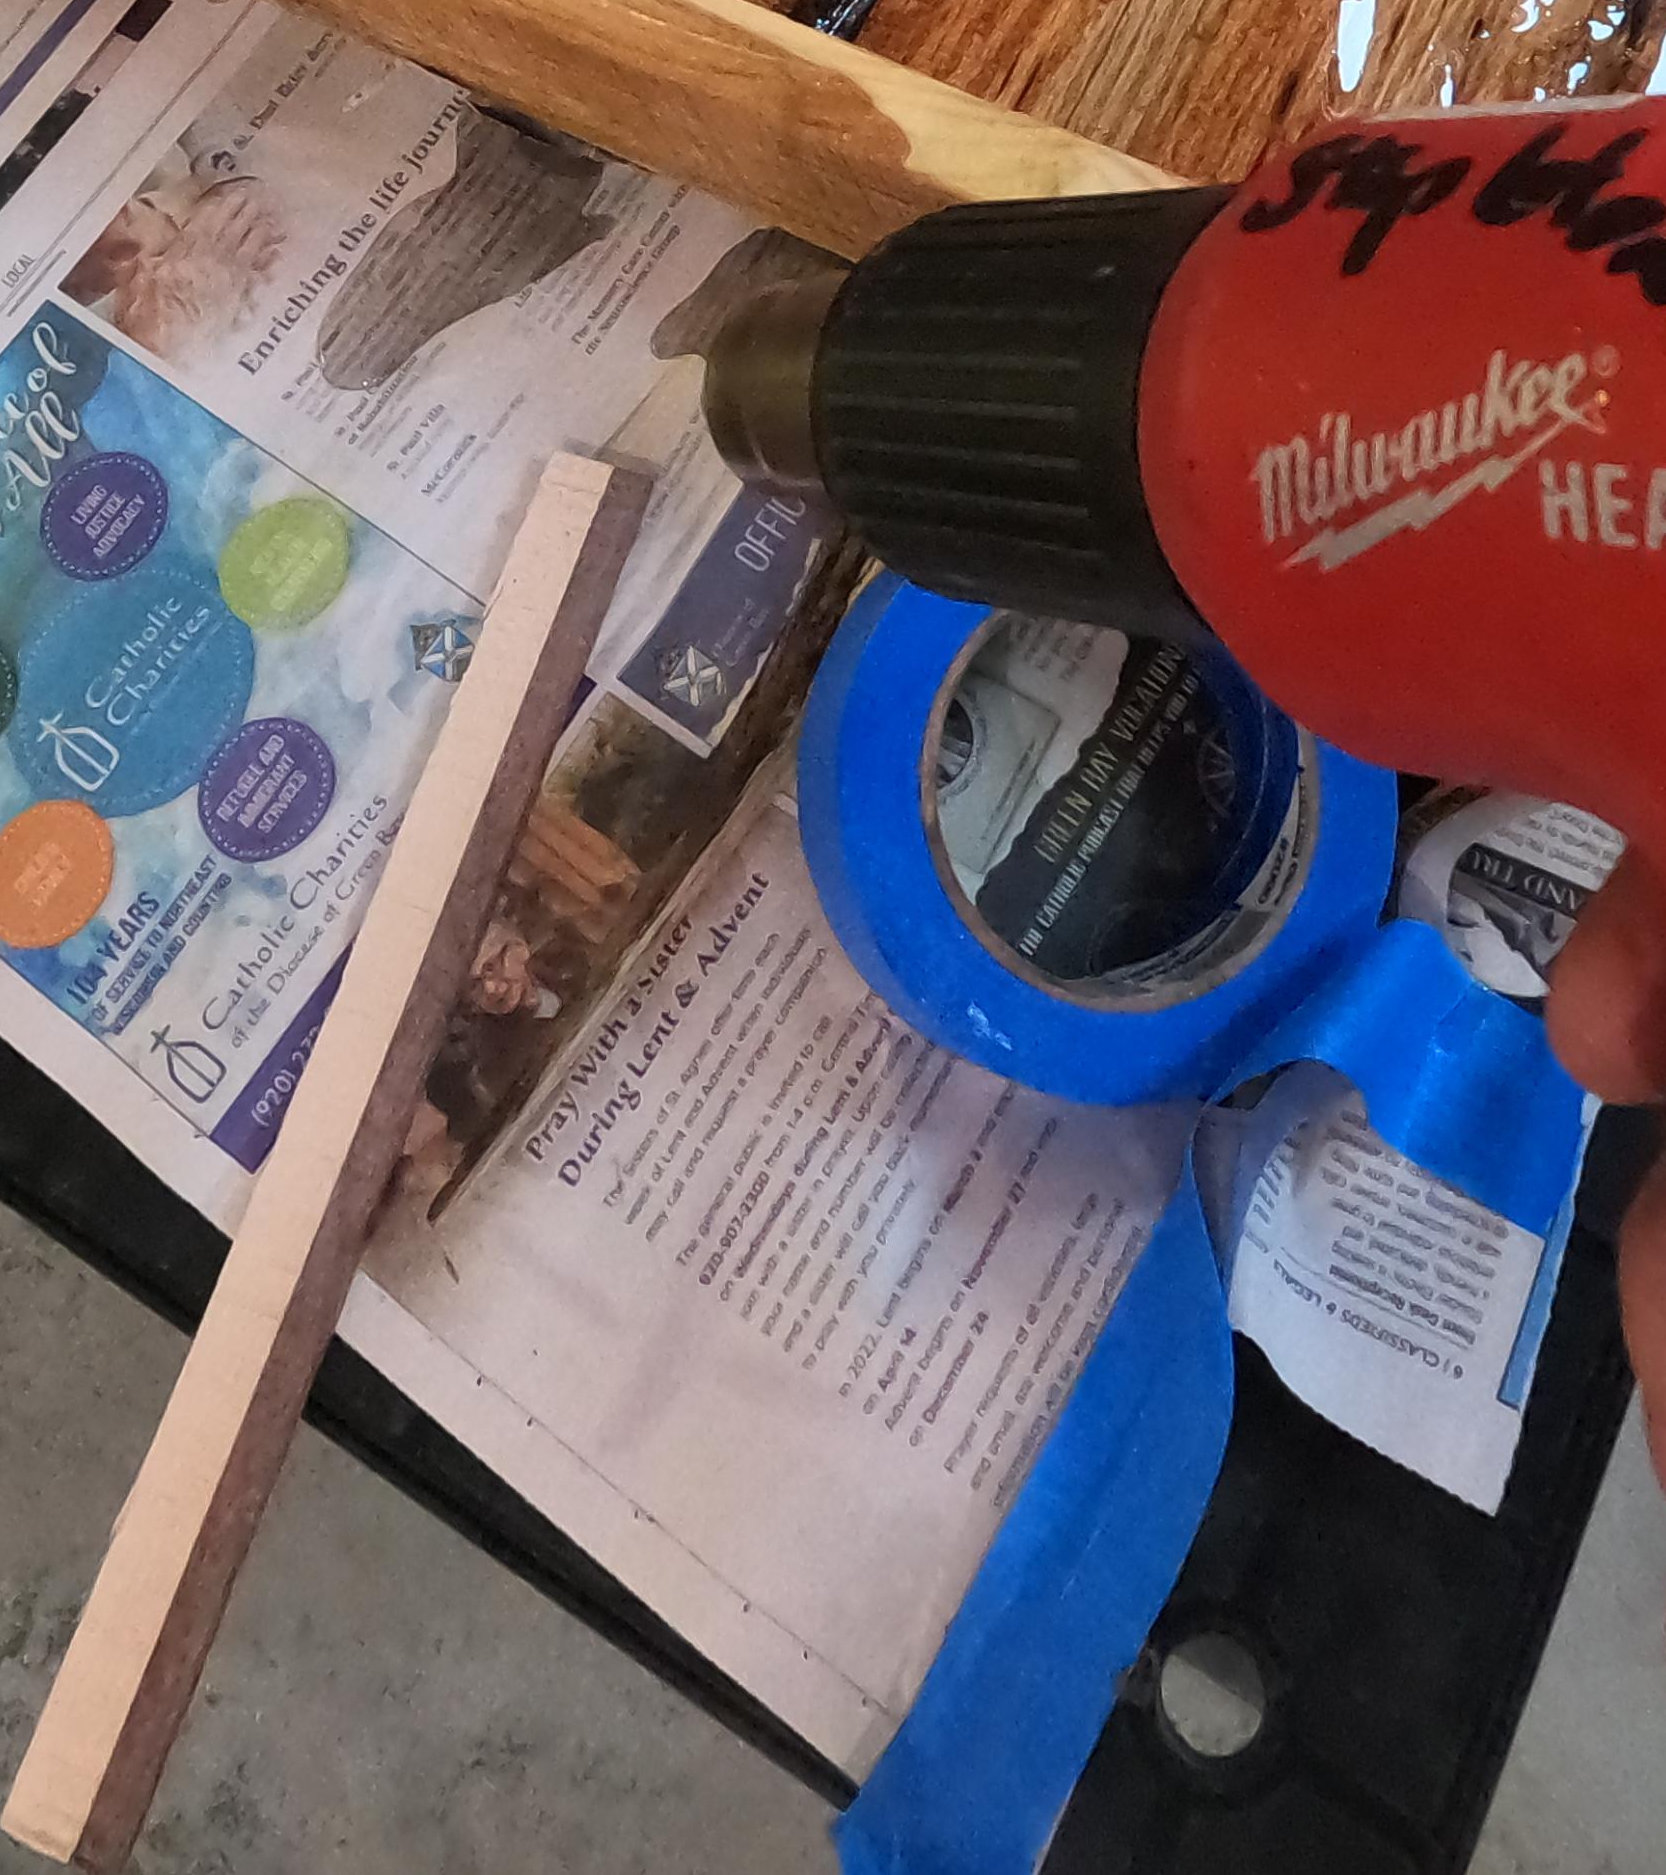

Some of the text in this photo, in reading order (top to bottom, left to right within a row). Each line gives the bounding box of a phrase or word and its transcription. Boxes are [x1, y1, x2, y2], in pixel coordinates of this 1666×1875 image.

[235, 249, 348, 379] Enriching
[333, 208, 377, 255] the
[368, 166, 411, 211] life
[2, 318, 87, 402] of
[69, 482, 108, 526] LIVING
[1250, 346, 1590, 544] Milwaukee
[82, 489, 127, 539] JUSTICE
[91, 493, 147, 559] ADVOCACY
[79, 589, 183, 713] Catholic
[100, 596, 212, 730] Charities
[1031, 788, 1094, 864] GREEN
[1077, 741, 1123, 792] BAY
[1034, 857, 1086, 928] CATHOLIC
[1074, 795, 1125, 863] PODCAST
[97, 888, 159, 966] YEARS
[203, 787, 387, 1034] Catholic Charities
[225, 1025, 249, 1050] of
[241, 989, 274, 1029] the
[266, 920, 327, 997] Diocese
[317, 898, 342, 926] of
[333, 842, 383, 905] Green
[89, 997, 113, 1023] OF
[142, 923, 167, 950] TO
[553, 865, 773, 1193] During Lent & Advent
[248, 1066, 300, 1128] (920)
[521, 911, 698, 1166] Pray With a Sister
[1265, 1258, 1327, 1307] LEGALS
[1338, 1307, 1441, 1369] CLASSIFIEDS
